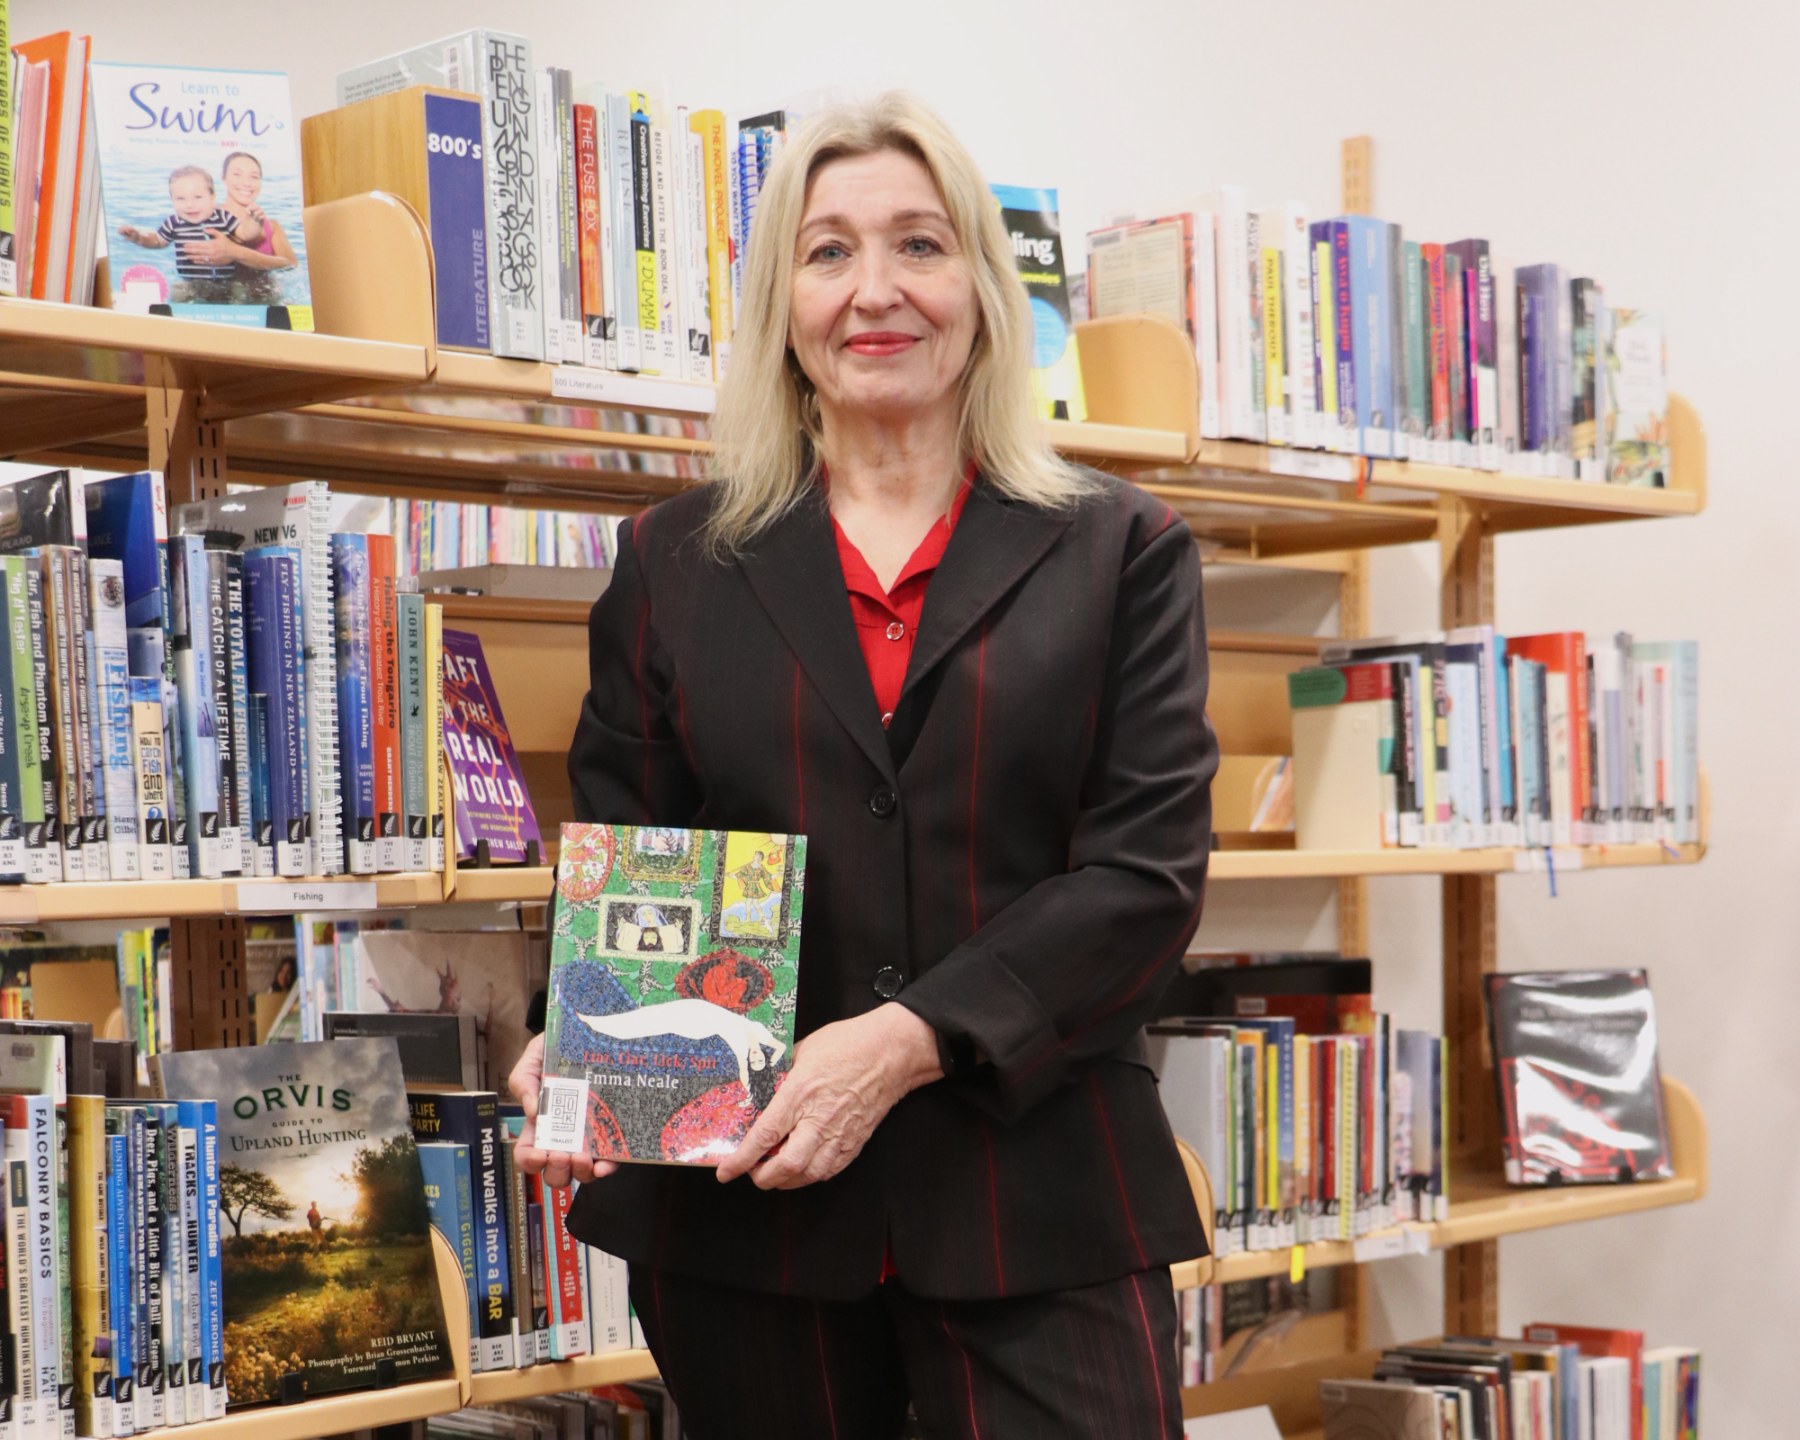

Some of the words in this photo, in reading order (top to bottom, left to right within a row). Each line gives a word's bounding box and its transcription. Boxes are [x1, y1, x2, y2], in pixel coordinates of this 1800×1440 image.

[181, 81, 220, 97] Learn
[225, 83, 240, 97] to
[125, 82, 271, 137] Swim
[427, 133, 482, 160] 800's
[582, 118, 594, 149] THE
[639, 125, 649, 166] Creative
[654, 132, 663, 166] BEFORE
[712, 124, 722, 145] THE
[0, 151, 12, 208] GIANTS
[583, 153, 595, 195] FUSE
[656, 171, 664, 189] AND
[713, 150, 723, 187] NOVEL
[640, 167, 650, 203] Writing
[584, 199, 597, 232] BOX
[657, 195, 666, 222] AFTER
[714, 189, 726, 244] PROJECT
[641, 204, 651, 249] Exercises
[659, 228, 667, 244] THE
[660, 249, 668, 271] BOOK
[1266, 258, 1276, 290] PAUL
[472, 228, 489, 346] LITERATURE
[661, 273, 669, 295] DEAL
[1268, 296, 1278, 360] THEROUX
[569, 379, 604, 391] Literature
[254, 526, 279, 545] NEW
[282, 523, 297, 539] V6
[27, 570, 40, 597] Fur,
[55, 573, 65, 615] BEGINNER'S
[72, 572, 82, 614] BEGINNER'S
[210, 577, 221, 601] THE
[228, 579, 243, 613] THE
[372, 585, 382, 614] History
[30, 600, 43, 630] Fish
[280, 563, 293, 649] FLY-FISHING
[382, 576, 395, 628] Fishing
[57, 615, 66, 637] GUIDE
[74, 615, 83, 636] GUIDE
[211, 606, 225, 655] CATCH
[358, 615, 368, 657] Science
[374, 627, 383, 644] Our
[408, 607, 420, 649] JOHN
[32, 633, 45, 659] and
[229, 621, 245, 671] TOTAL
[385, 631, 395, 656] the
[59, 648, 68, 680] HUNTING
[76, 647, 86, 679] HUNTING
[215, 660, 226, 676] OF
[284, 653, 293, 669] IN
[375, 645, 384, 678] Greatest
[409, 655, 421, 698] KENT
[443, 653, 481, 687] AFT
[33, 662, 50, 723] Phantom
[79, 685, 89, 715] FISHING
[217, 680, 226, 688] A
[231, 673, 246, 695] FLY
[285, 673, 295, 696] NEW
[360, 675, 370, 706] Trout
[376, 681, 385, 704] Trout
[385, 658, 397, 730] Tongariro
[63, 686, 71, 715] FISHING
[376, 705, 386, 727] River
[458, 700, 490, 725] THE
[64, 724, 73, 741] NEW
[81, 723, 90, 740] NEW
[109, 663, 130, 773] Fishing
[215, 691, 231, 762] LIFETIME
[360, 707, 371, 749] Fishing
[39, 726, 52, 761] Reds
[233, 710, 249, 773] FISHING
[286, 706, 297, 767] ZEALAND
[447, 731, 503, 767] REAL
[65, 742, 75, 774] ZEALAND
[82, 741, 92, 773] ZEALAND
[43, 780, 54, 801] Phil
[452, 772, 525, 809] WORLD
[292, 891, 325, 903] Fishing
[278, 1073, 302, 1083] THE
[584, 1070, 632, 1088] Emma
[636, 1072, 681, 1090] Neale
[233, 1084, 352, 1120] ORVIS
[415, 1102, 435, 1118] LIFE
[204, 1123, 216, 1134] A
[272, 1119, 305, 1129] GUIDE
[310, 1117, 323, 1125] TO
[35, 1108, 50, 1206] FALCONRY
[135, 1122, 145, 1173] HUNTING
[145, 1128, 159, 1159] Deer,
[204, 1135, 218, 1182] Hunter
[480, 1127, 494, 1172] Man
[114, 1139, 125, 1182] HUNTING
[145, 1161, 159, 1188] Pigs,
[166, 1125, 179, 1212] Wilderness
[184, 1144, 198, 1197] TRACKS
[136, 1174, 146, 1226] SMARTER
[148, 1191, 160, 1208] and
[206, 1184, 218, 1196] in
[482, 1174, 498, 1225] Walks
[515, 1172, 525, 1225] POLITICAL
[16, 1213, 26, 1231] THE
[116, 1185, 128, 1251] ADVENTURES
[206, 1199, 220, 1258] Paradise
[559, 1210, 572, 1252] JOKES
[40, 1211, 53, 1279] BASICS
[137, 1228, 146, 1247] FOR
[148, 1227, 161, 1259] Little
[186, 1219, 199, 1274] HUNTER
[461, 1221, 474, 1280] GIGGLES
[484, 1229, 500, 1265] into
[518, 1225, 528, 1276] PUTDOWN
[17, 1233, 29, 1275] WORLD'S
[138, 1248, 147, 1267] BIG
[169, 1216, 182, 1301] HUNTER
[149, 1262, 162, 1279] Bit
[487, 1269, 499, 1280] a
[18, 1277, 30, 1323] GREATEST
[138, 1269, 148, 1305] GAME
[149, 1282, 162, 1295] of
[209, 1279, 219, 1308] ZEFF
[488, 1282, 503, 1322] BAR
[150, 1298, 163, 1326] Bull!
[188, 1292, 199, 1320] John
[20, 1325, 31, 1366] HUNTING
[139, 1321, 148, 1346] HANS
[189, 1321, 201, 1355] Royle
[210, 1309, 221, 1363] VERONES
[370, 1337, 395, 1349] REID
[396, 1330, 436, 1345] BRYANT
[307, 1355, 354, 1369] Photography
[354, 1354, 364, 1363] by
[365, 1350, 386, 1360] Brian
[386, 1342, 439, 1357] Grossenbacher
[342, 1363, 377, 1375] Foreword
[412, 1354, 440, 1364] Perkins
